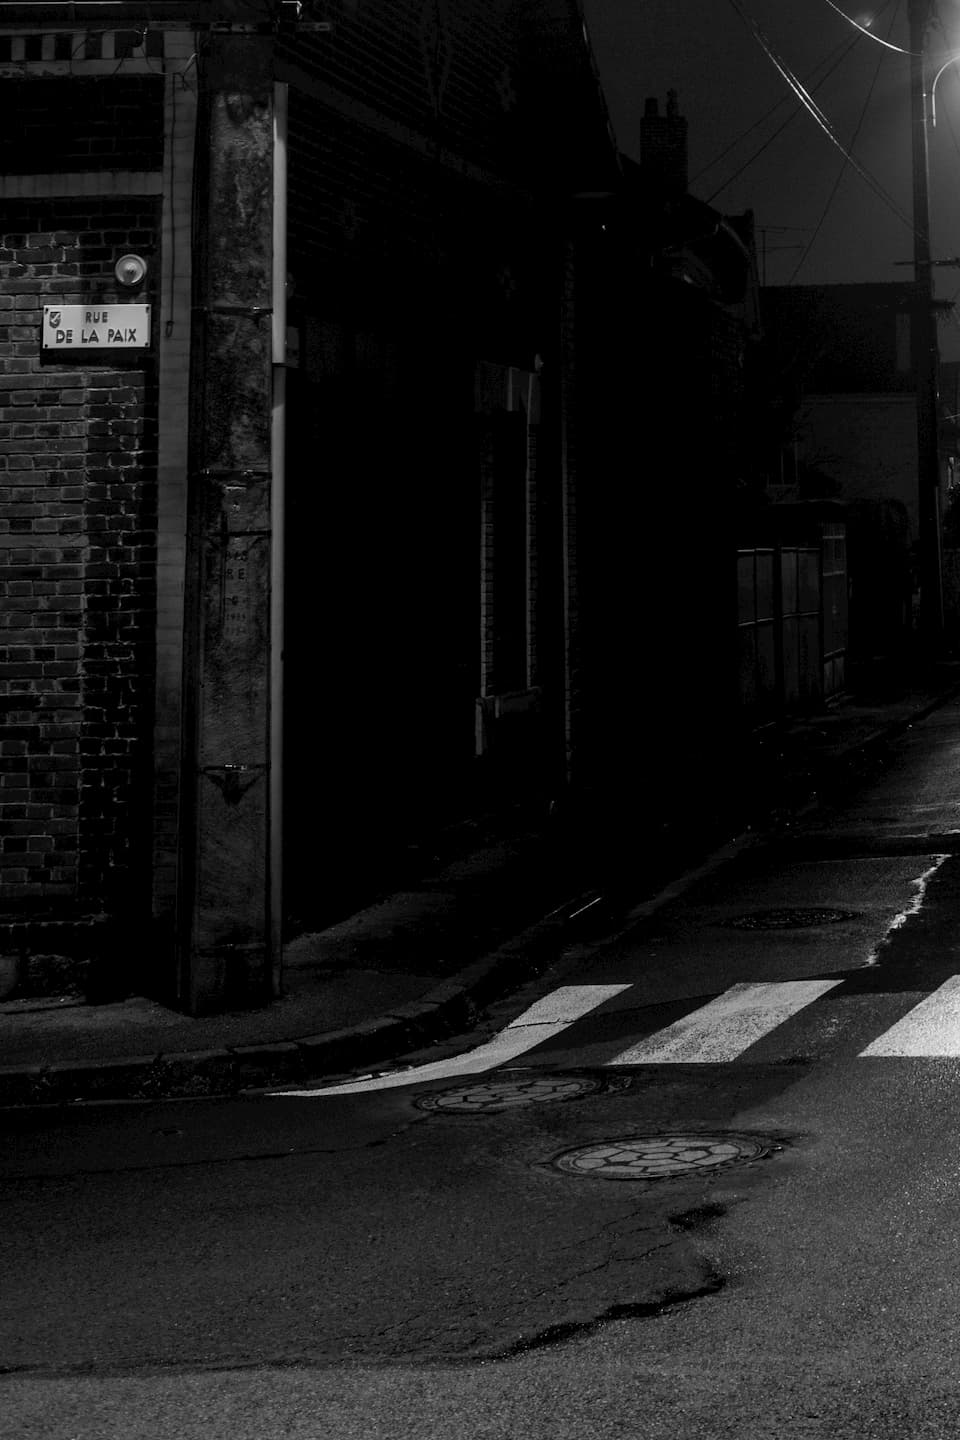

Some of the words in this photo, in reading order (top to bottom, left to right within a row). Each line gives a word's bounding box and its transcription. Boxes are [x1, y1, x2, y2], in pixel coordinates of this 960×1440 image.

[85, 311, 108, 323] RUE
[55, 329, 73, 344] DE
[81, 329, 99, 343] LA
[107, 328, 137, 343] PAIX
